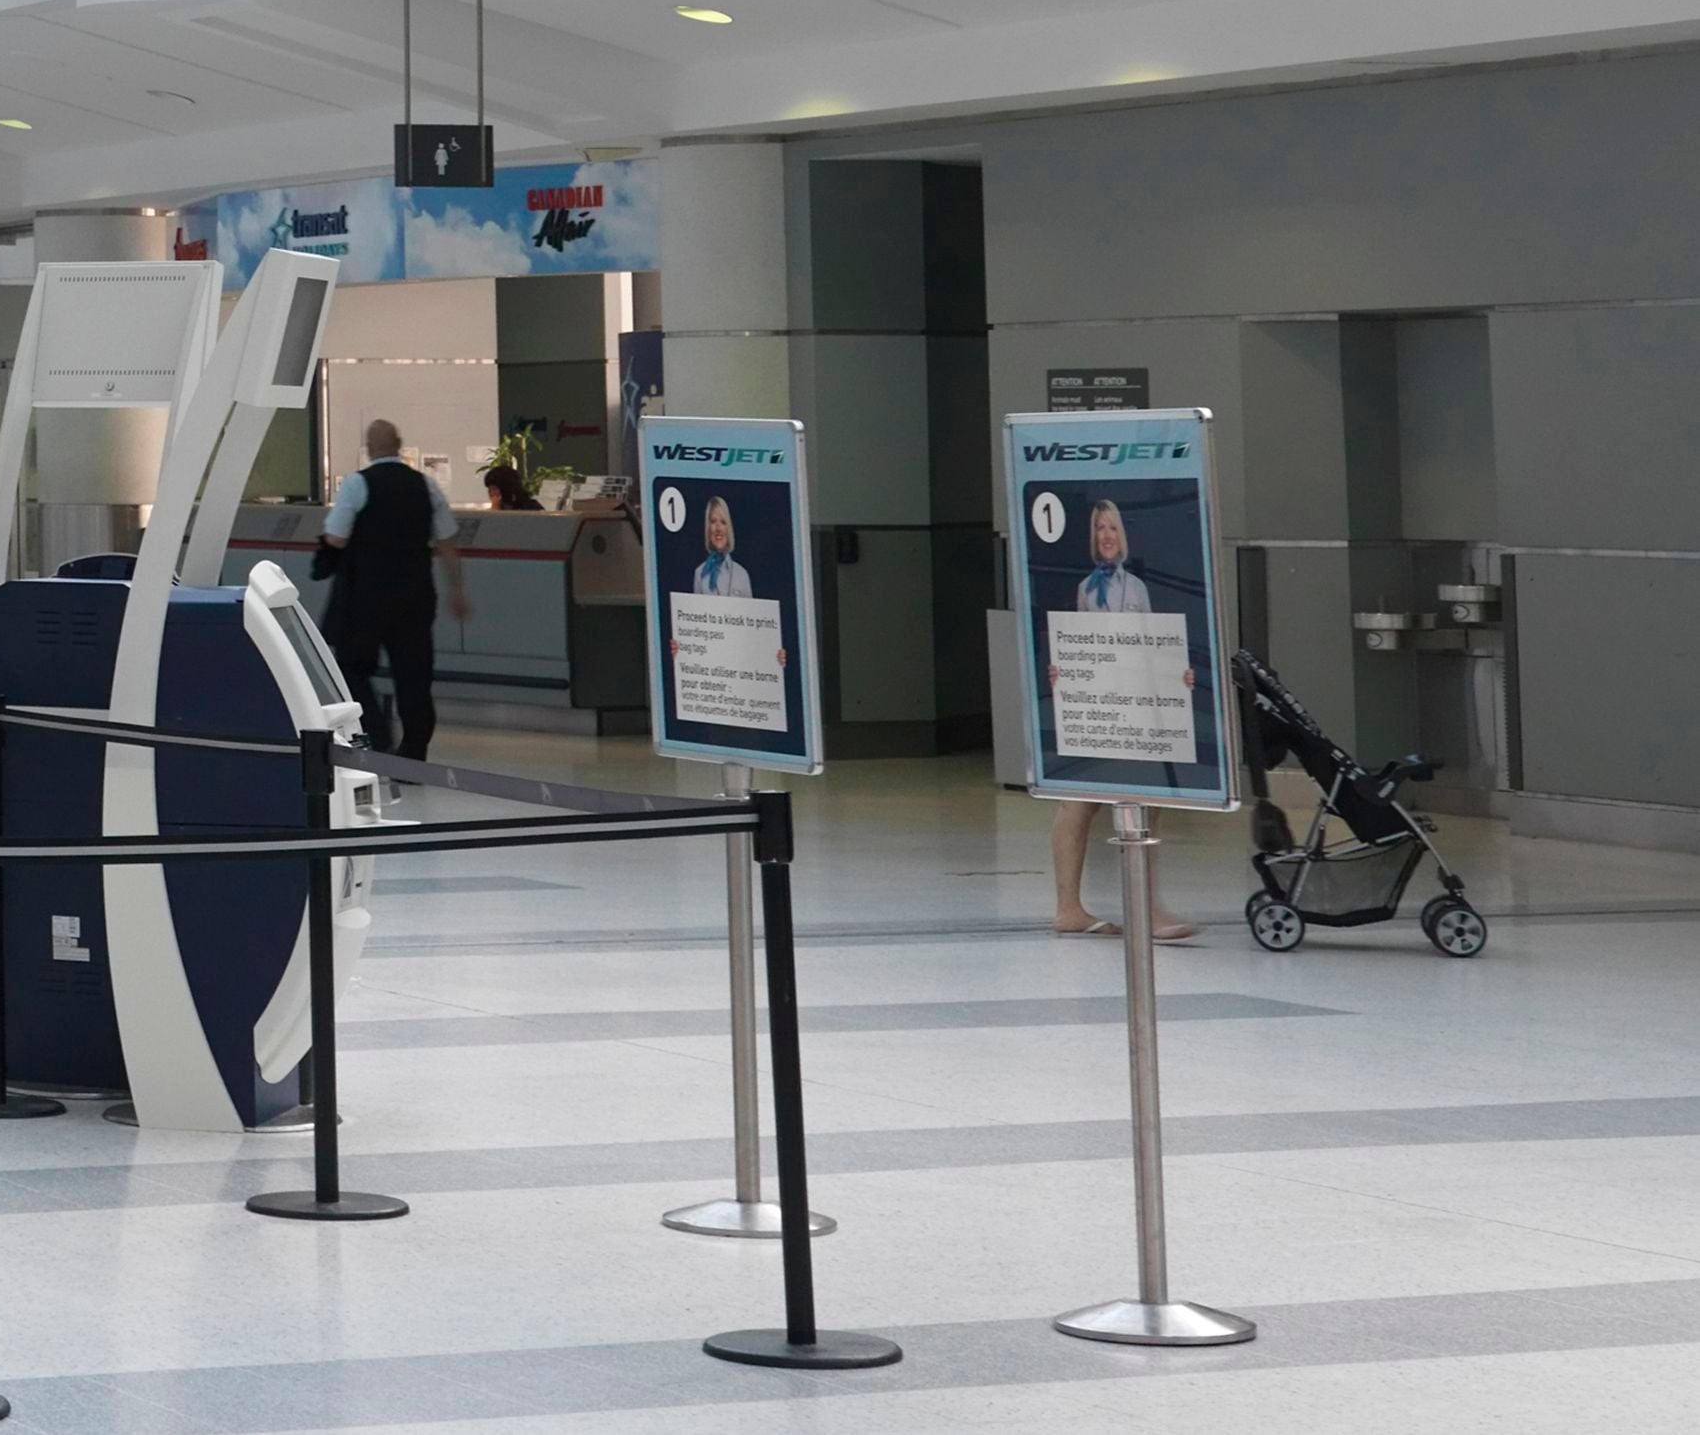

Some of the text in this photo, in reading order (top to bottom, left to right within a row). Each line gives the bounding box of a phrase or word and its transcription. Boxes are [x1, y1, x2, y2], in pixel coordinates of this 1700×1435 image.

[527, 185, 603, 211] CANADIAN
[291, 205, 348, 239] transat
[653, 443, 770, 467] WESTJET
[1023, 442, 1173, 465] WESTJET
[668, 496, 676, 524] 1
[1042, 503, 1052, 534] 1
[677, 609, 778, 630] Proceed to a kiosk to print:
[678, 627, 725, 641] boarding pass
[1057, 631, 1184, 648] Proceed to a kiosk to print:
[693, 644, 707, 656] tags
[1057, 650, 1117, 665] boarding pass
[680, 662, 779, 683] Veuillez utiliser une borne
[1059, 666, 1095, 682] bag tags
[681, 678, 699, 690] pour
[700, 679, 728, 692] obtenir
[681, 692, 699, 701] votre
[700, 693, 717, 703] carte
[1060, 690, 1185, 708] Veuillez utiliser une borne
[682, 703, 694, 712] vos
[730, 709, 738, 718] de
[739, 710, 768, 723] bagages
[1062, 710, 1084, 722] pour
[1086, 708, 1120, 721] obtenir
[1063, 724, 1085, 734] votre
[1086, 725, 1107, 735] carte
[1063, 736, 1173, 755] vos étiquettes de bagages
